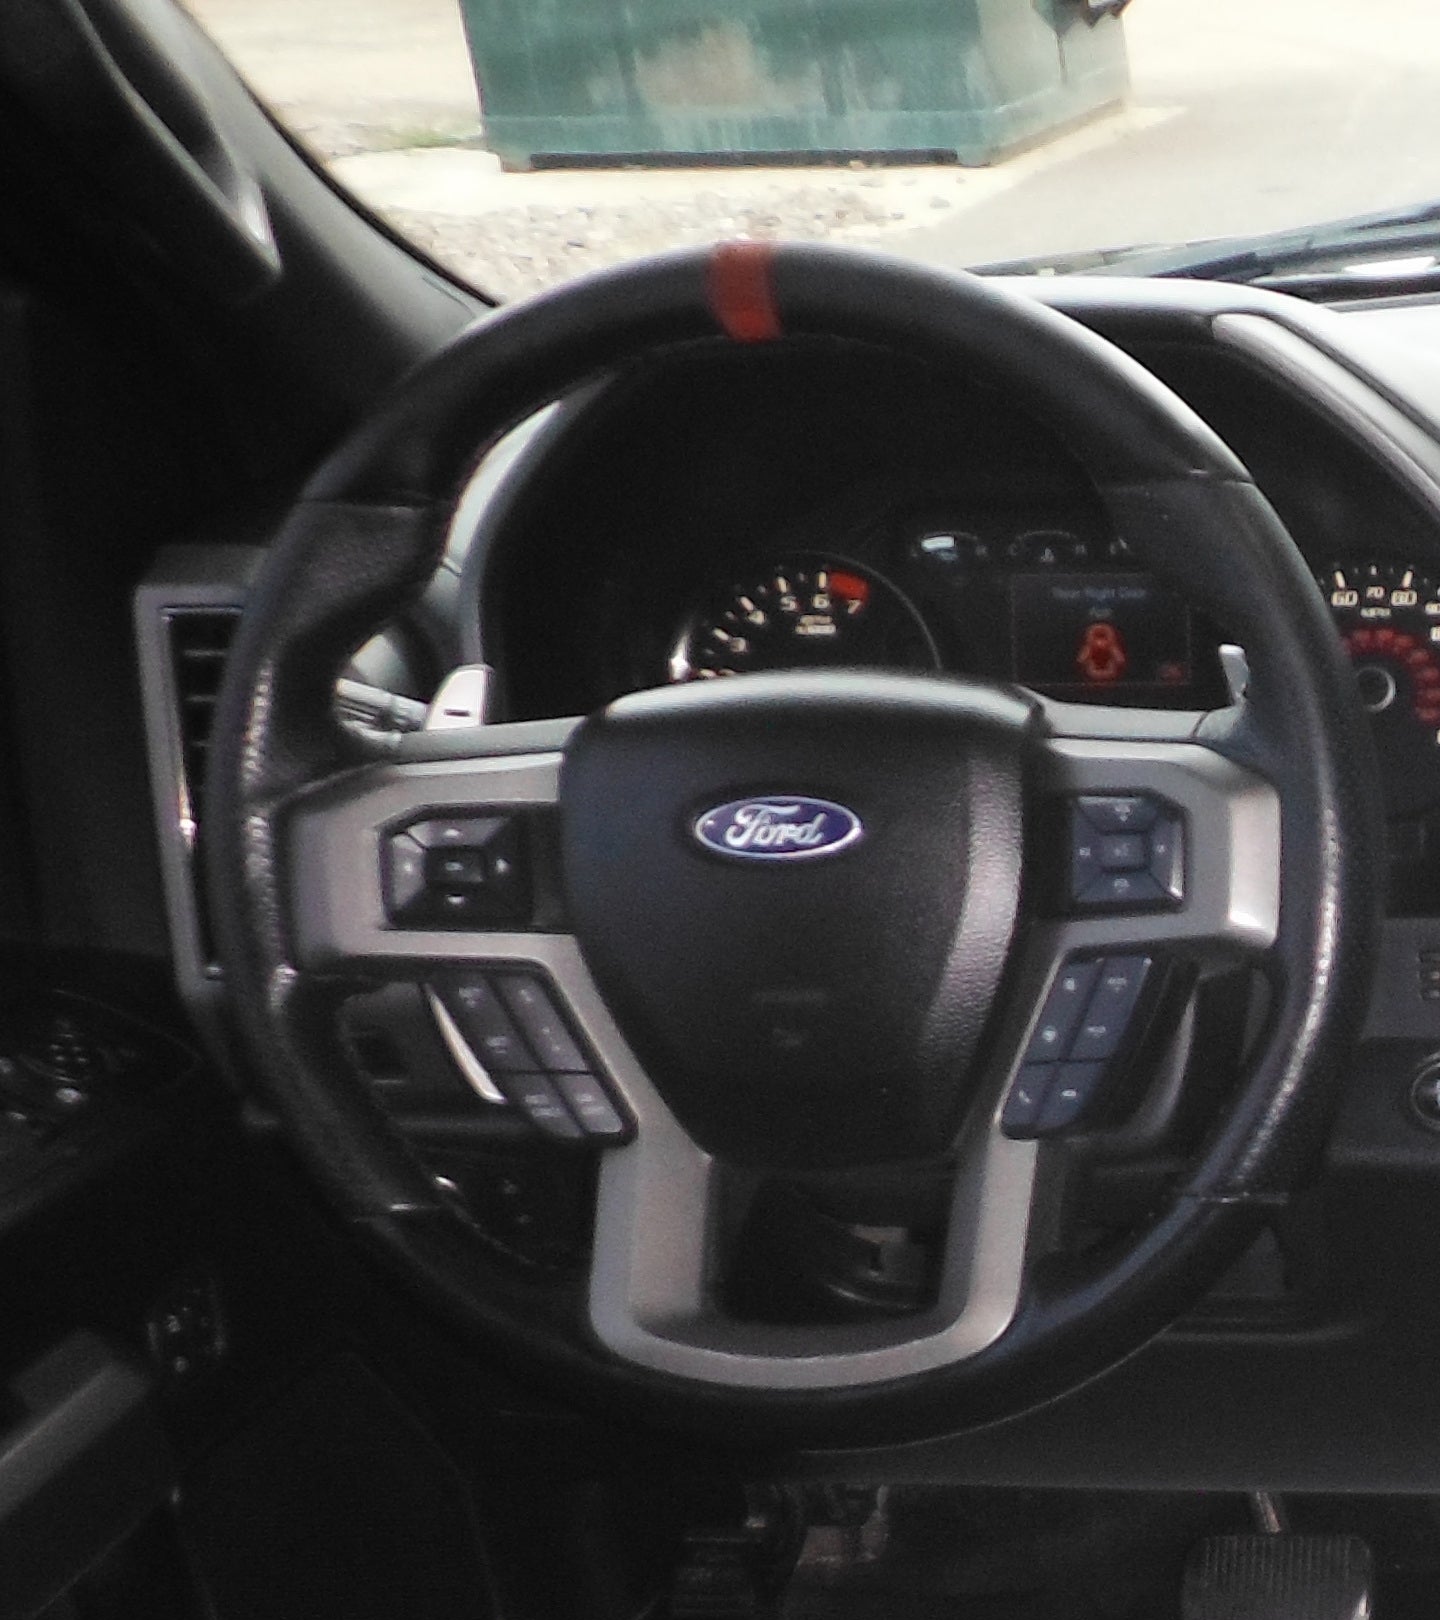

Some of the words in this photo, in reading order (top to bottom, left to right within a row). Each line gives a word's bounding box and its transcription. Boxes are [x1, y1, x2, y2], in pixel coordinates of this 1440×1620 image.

[781, 597, 797, 611] 5
[813, 594, 830, 608] 6
[725, 804, 827, 847] Ford
